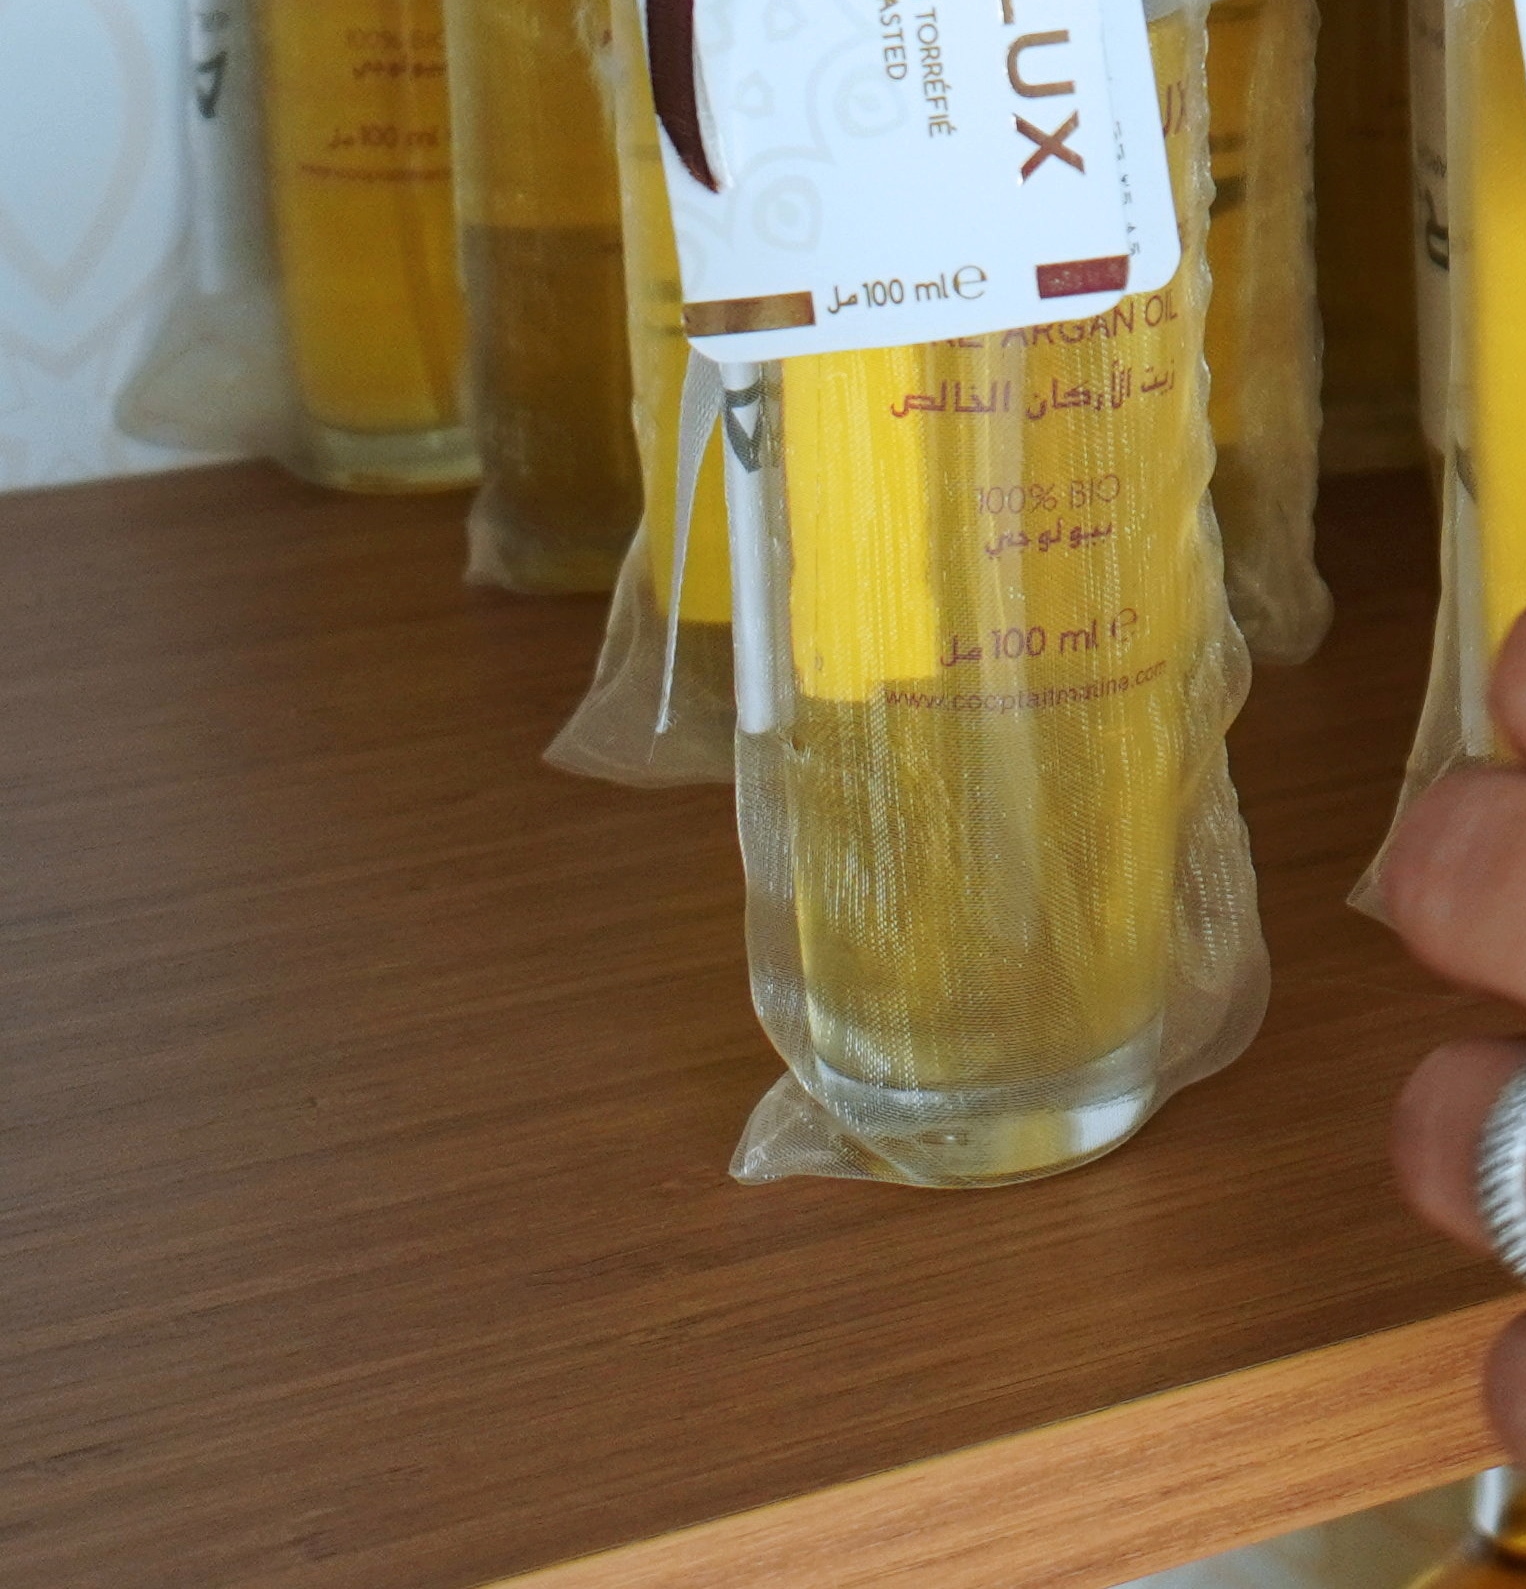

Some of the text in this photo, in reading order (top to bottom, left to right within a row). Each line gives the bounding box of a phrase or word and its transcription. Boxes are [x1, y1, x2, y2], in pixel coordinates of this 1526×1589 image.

[915, 8, 955, 137] TORRÉFIÉ
[862, 277, 905, 309] 100
[914, 274, 949, 303] ml
[1143, 292, 1178, 325] OIL
[978, 475, 1120, 514] 100% BIO
[990, 626, 1047, 660] 100
[1057, 620, 1101, 652] ml
